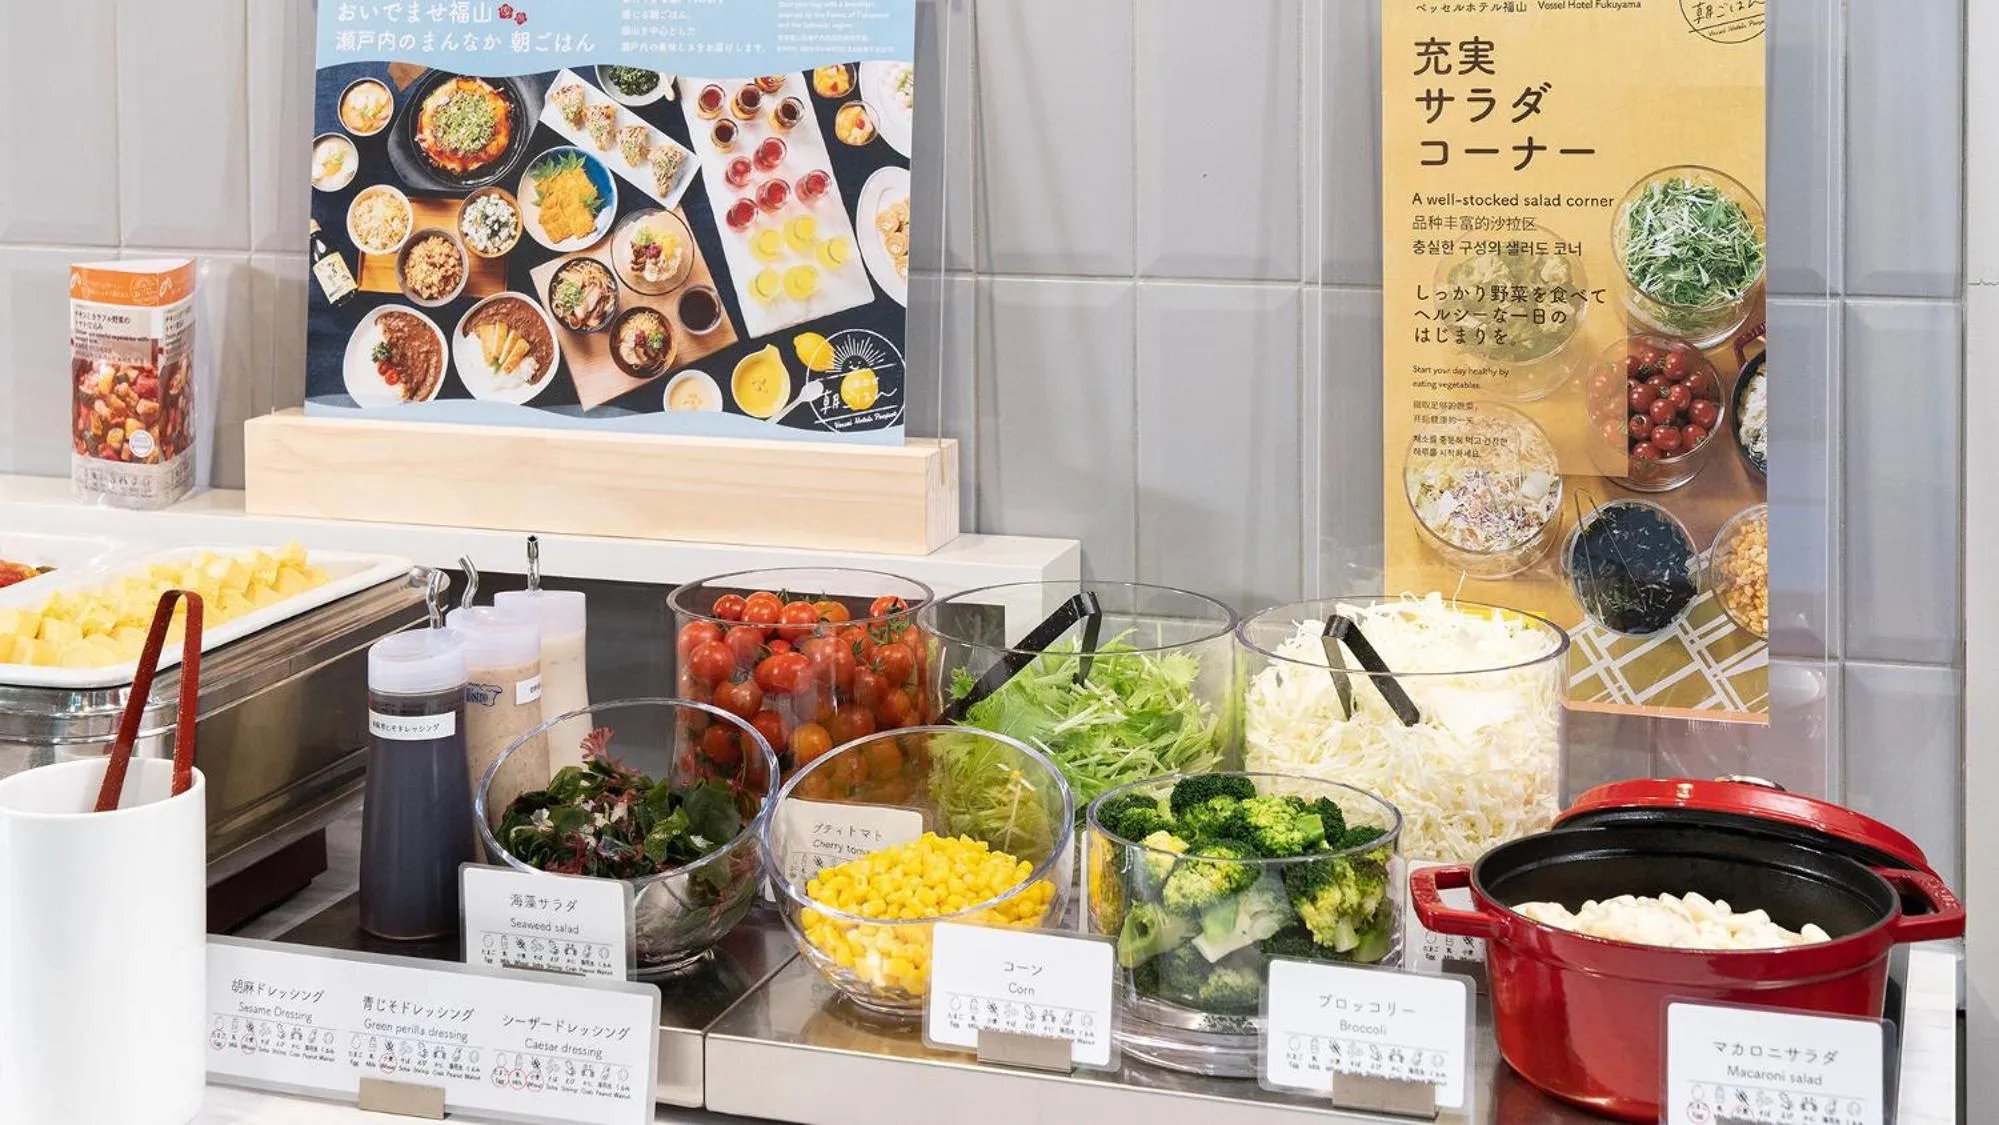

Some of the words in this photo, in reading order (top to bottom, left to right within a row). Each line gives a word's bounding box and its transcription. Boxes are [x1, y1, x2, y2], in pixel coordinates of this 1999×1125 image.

[338, 1, 492, 25] おいでませ福山
[1416, 1, 1527, 13] ベッセルホテル福山
[1537, 1, 1566, 9] Vessel
[1568, 0, 1593, 9] Hotel
[335, 32, 502, 52] 瀬戸内のまんなか
[511, 32, 597, 53] 朝ごはん
[1414, 36, 1496, 76] 充実
[1415, 82, 1552, 124] サラダ
[1420, 136, 1596, 172] コーナー
[1412, 193, 1422, 205] A
[1427, 193, 1519, 206] well-stocked
[1524, 194, 1561, 207] salad
[1567, 196, 1614, 207] corner
[1412, 215, 1537, 232] 品种丰富的沙拉区
[1413, 241, 1454, 255] 충실한
[1460, 241, 1501, 256] 구성의
[1506, 241, 1548, 256] 샐러드
[1554, 242, 1582, 256] 코너
[1416, 284, 1606, 304] しっかり野菜を食べて
[1414, 308, 1567, 325] ヘルシーな一日の
[1415, 327, 1517, 345] はじまりを。
[1413, 365, 1431, 374] Start
[1453, 366, 1466, 376] day
[1499, 368, 1510, 377] by
[1413, 380, 1437, 390] eating
[813, 839, 843, 853] Cherry
[510, 893, 578, 913] 海藻サラダ
[510, 917, 552, 932] Seaweed
[555, 924, 579, 935] salad
[1004, 962, 1042, 976] コーン
[231, 979, 325, 1003] 胡麻ドレッシング
[1008, 982, 1035, 996] Corn
[238, 1002, 271, 1016] Sesame
[274, 1006, 313, 1024] Dressing
[362, 996, 475, 1021] 青じそドレッシング
[1319, 993, 1415, 1016] ブロッコリー
[364, 1018, 393, 1031] Green
[396, 1023, 424, 1036] perilla
[427, 1028, 468, 1044] dressing
[502, 1014, 631, 1041] シーザードレッシング
[1339, 1019, 1387, 1036] Broccoli
[525, 1038, 558, 1051] Caesar
[561, 1043, 603, 1060] dressing
[1713, 1041, 1838, 1066] マカロニサラダ
[1727, 1065, 1785, 1081] Macaroni
[1790, 1070, 1822, 1085] salad
